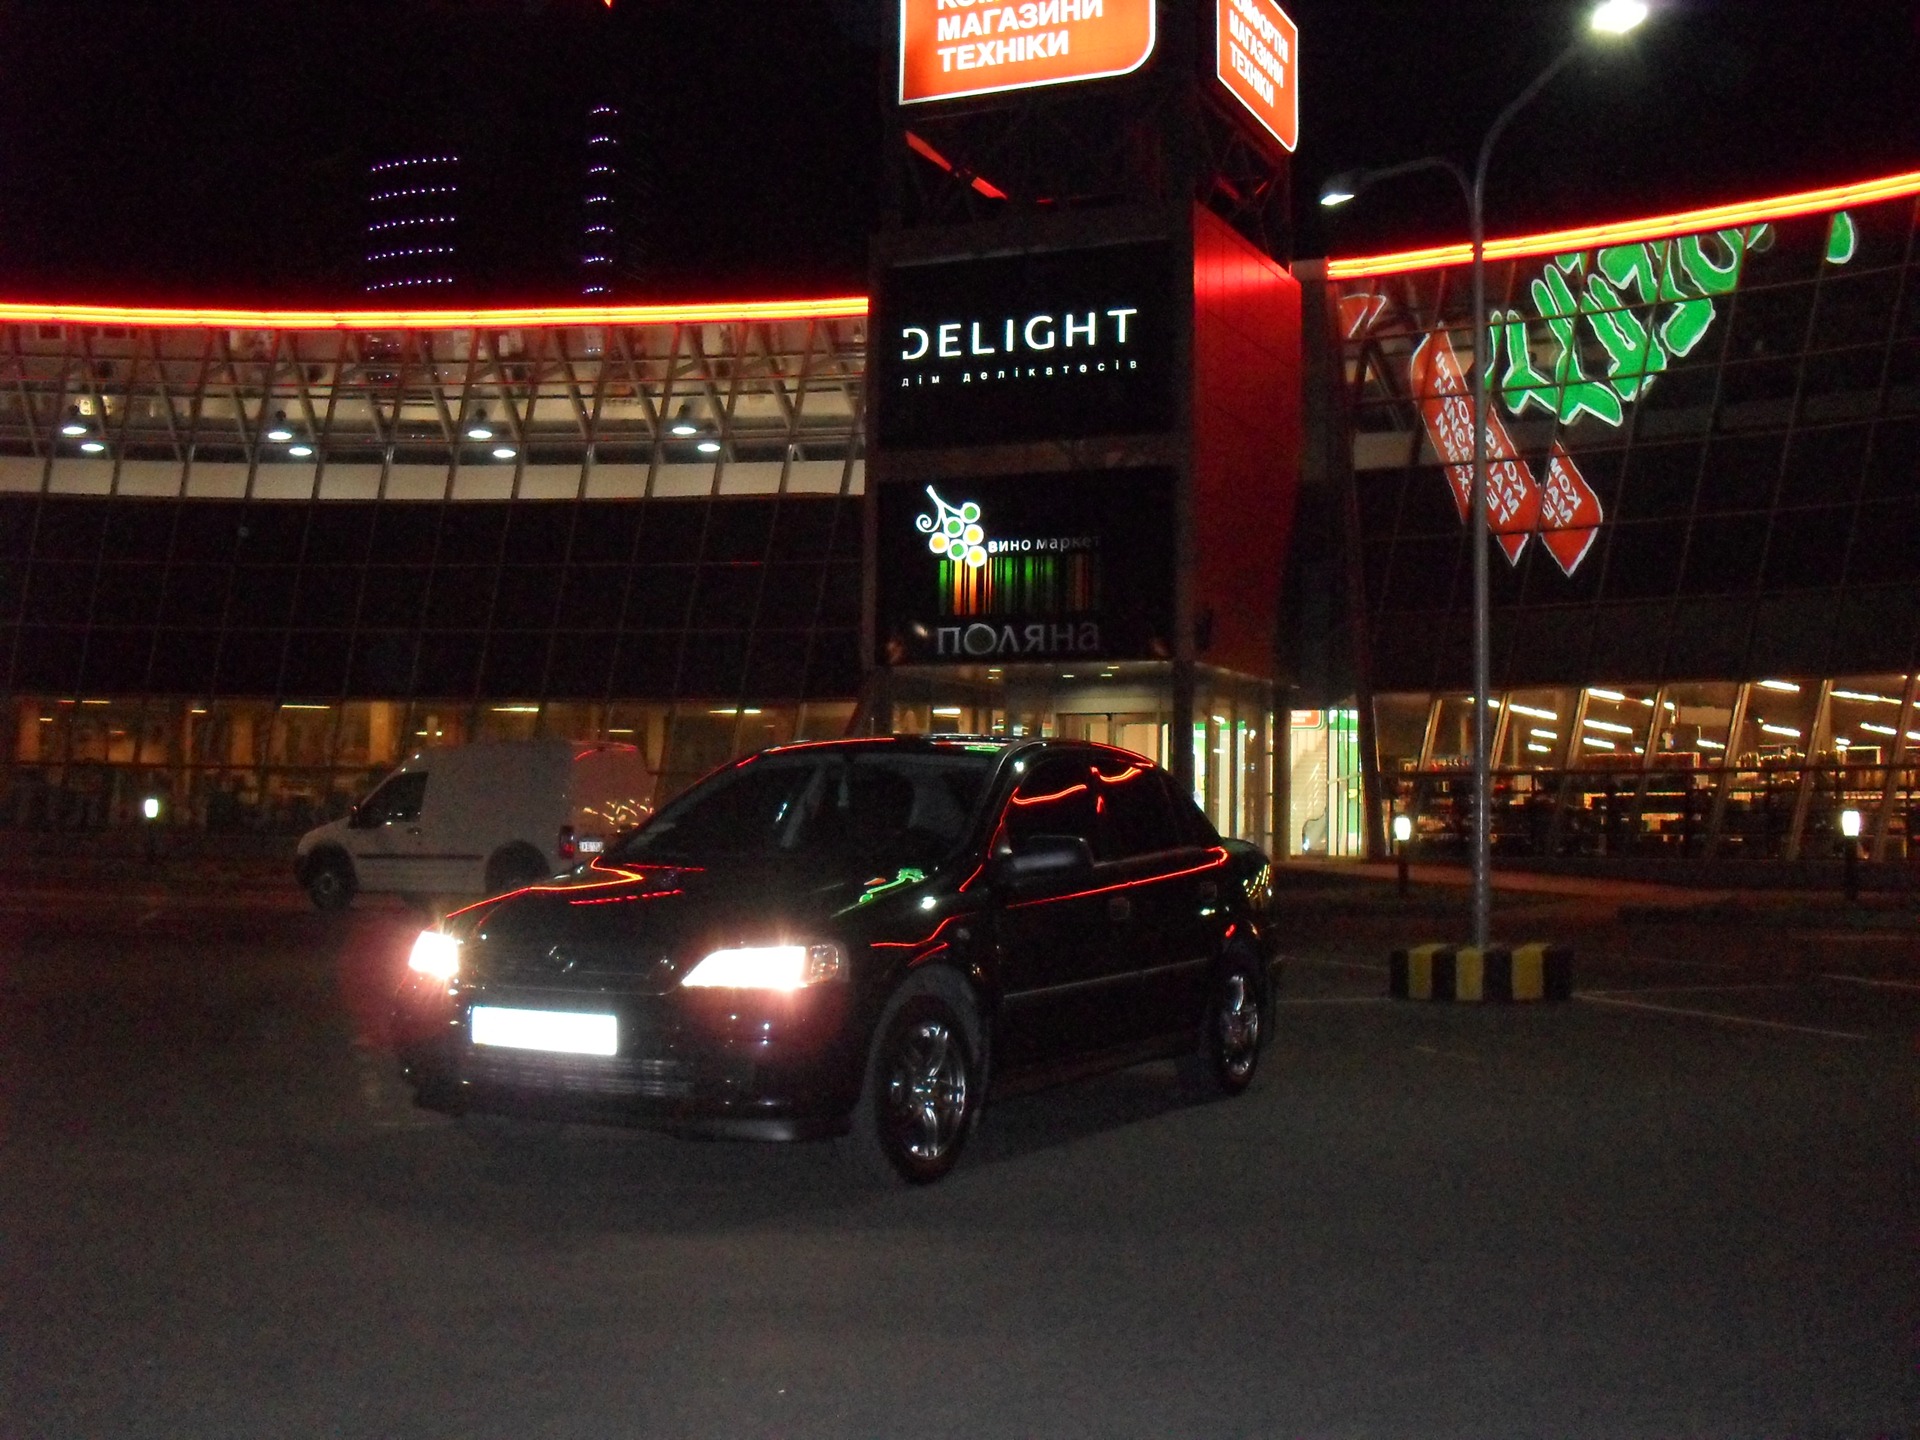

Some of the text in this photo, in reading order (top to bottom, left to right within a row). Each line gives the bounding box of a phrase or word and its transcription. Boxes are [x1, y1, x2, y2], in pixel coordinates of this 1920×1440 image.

[937, 0, 1103, 42] МАГАЗИНИ
[1229, 0, 1289, 64] ОМФОРТНІ
[937, 29, 1069, 73] ТЕХНІКИ
[1229, 39, 1275, 108] ТЕХНІКИ
[901, 307, 1138, 361] DELIGHT
[901, 358, 1138, 387] дім делікатесів
